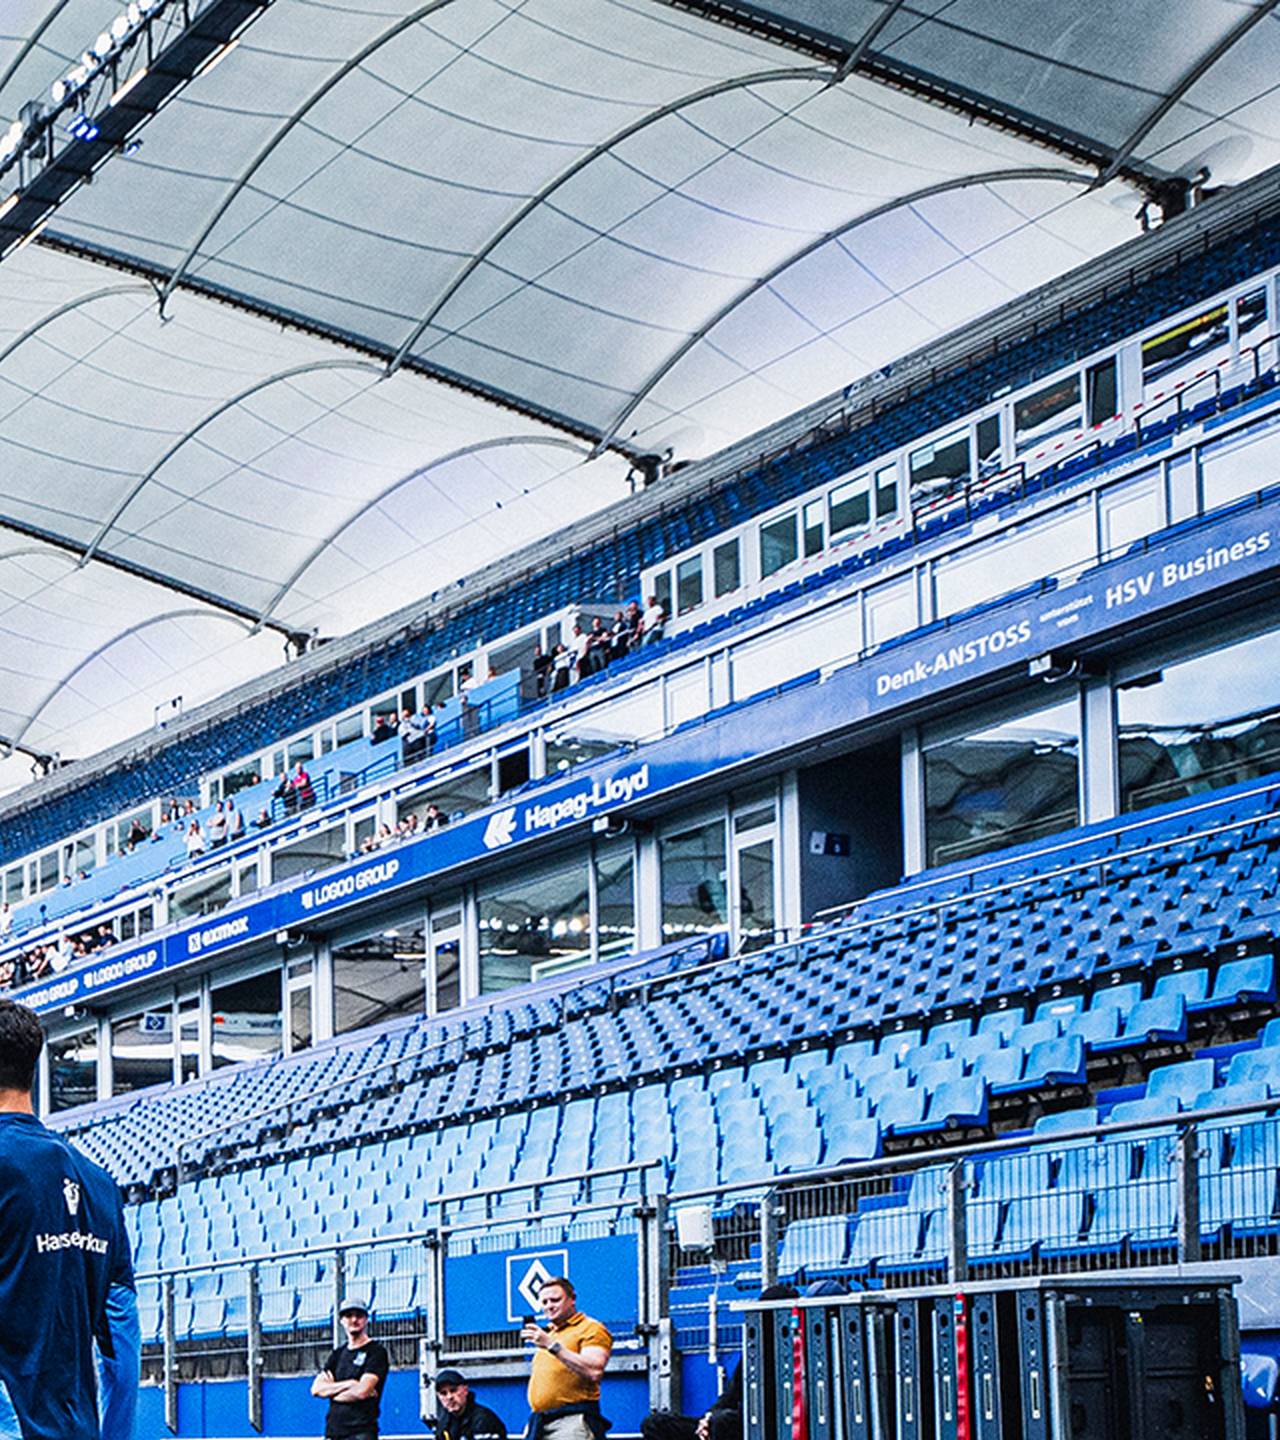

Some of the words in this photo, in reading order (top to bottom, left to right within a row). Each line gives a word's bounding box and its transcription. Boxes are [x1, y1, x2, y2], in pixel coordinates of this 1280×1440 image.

[1105, 571, 1155, 609] HSV
[1162, 531, 1272, 588] Business
[876, 620, 1033, 696] Denk-ANSTOSS
[525, 763, 649, 832] Hapag-Lloyd
[355, 858, 399, 890] GROUP
[124, 949, 158, 975] GROUP
